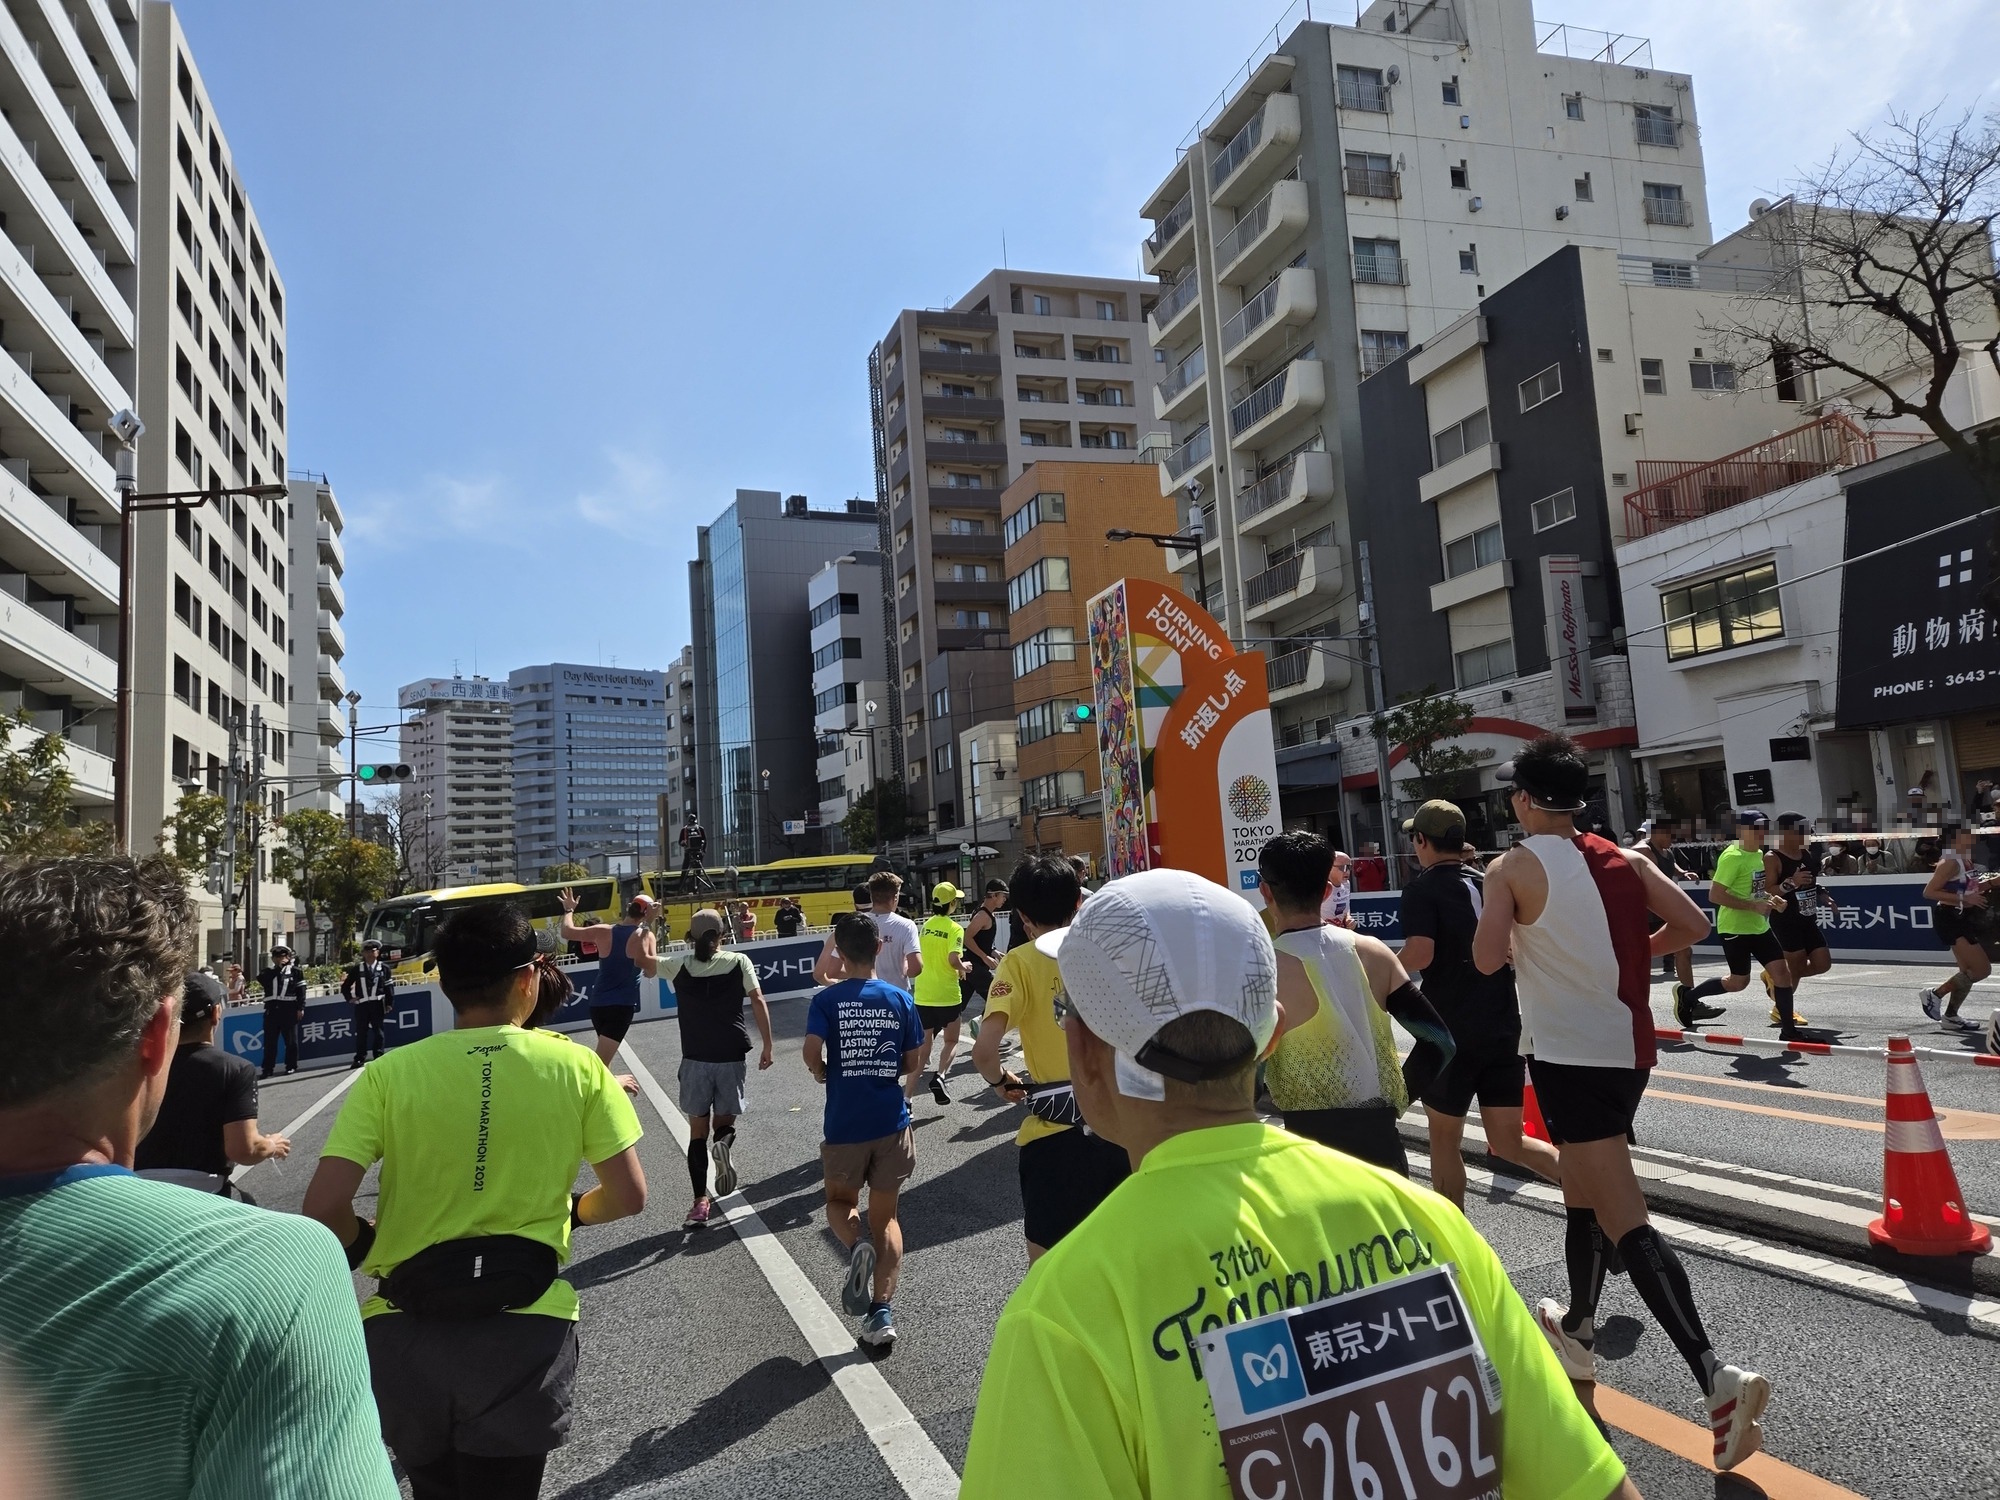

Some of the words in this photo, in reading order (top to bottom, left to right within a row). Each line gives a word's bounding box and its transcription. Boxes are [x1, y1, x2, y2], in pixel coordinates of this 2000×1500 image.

[1560, 580, 1578, 645] Raffinato
[1145, 607, 1194, 653] POINT
[1157, 593, 1223, 661] TURNING
[563, 670, 581, 682] Day
[583, 671, 604, 683] Nice
[606, 673, 628, 685] Hotel
[630, 675, 654, 688] Tokyo
[1945, 669, 2000, 686] 3643-
[409, 688, 427, 702] SEINO
[1179, 668, 1248, 751] 折返し点
[1232, 825, 1275, 838] TOKYO
[1234, 837, 1272, 847] MARATHO
[1234, 847, 1264, 863] 20
[1350, 911, 1399, 928] 東京メ
[1815, 904, 1934, 929] 東京メトロ
[753, 956, 815, 981] メトロ
[837, 1001, 850, 1009] We
[838, 1008, 887, 1019] INCLUSIVE
[301, 1009, 419, 1044] 東京ロ
[839, 1019, 900, 1030] EMPOWERING
[840, 1038, 877, 1048] LASTING
[841, 1048, 875, 1059] IMPACT
[881, 1060, 897, 1068] equal
[481, 1061, 492, 1098] TOKYO
[477, 1100, 490, 1163] MARATHON
[473, 1165, 486, 1192] 2021
[1210, 1239, 1272, 1288] 31th
[1305, 1294, 1459, 1371] 東京メトロ
[1229, 1428, 1278, 1446] BLOCK/CORRAL
[1302, 1375, 1497, 1500] 26162
[1240, 1449, 1286, 1500] C
